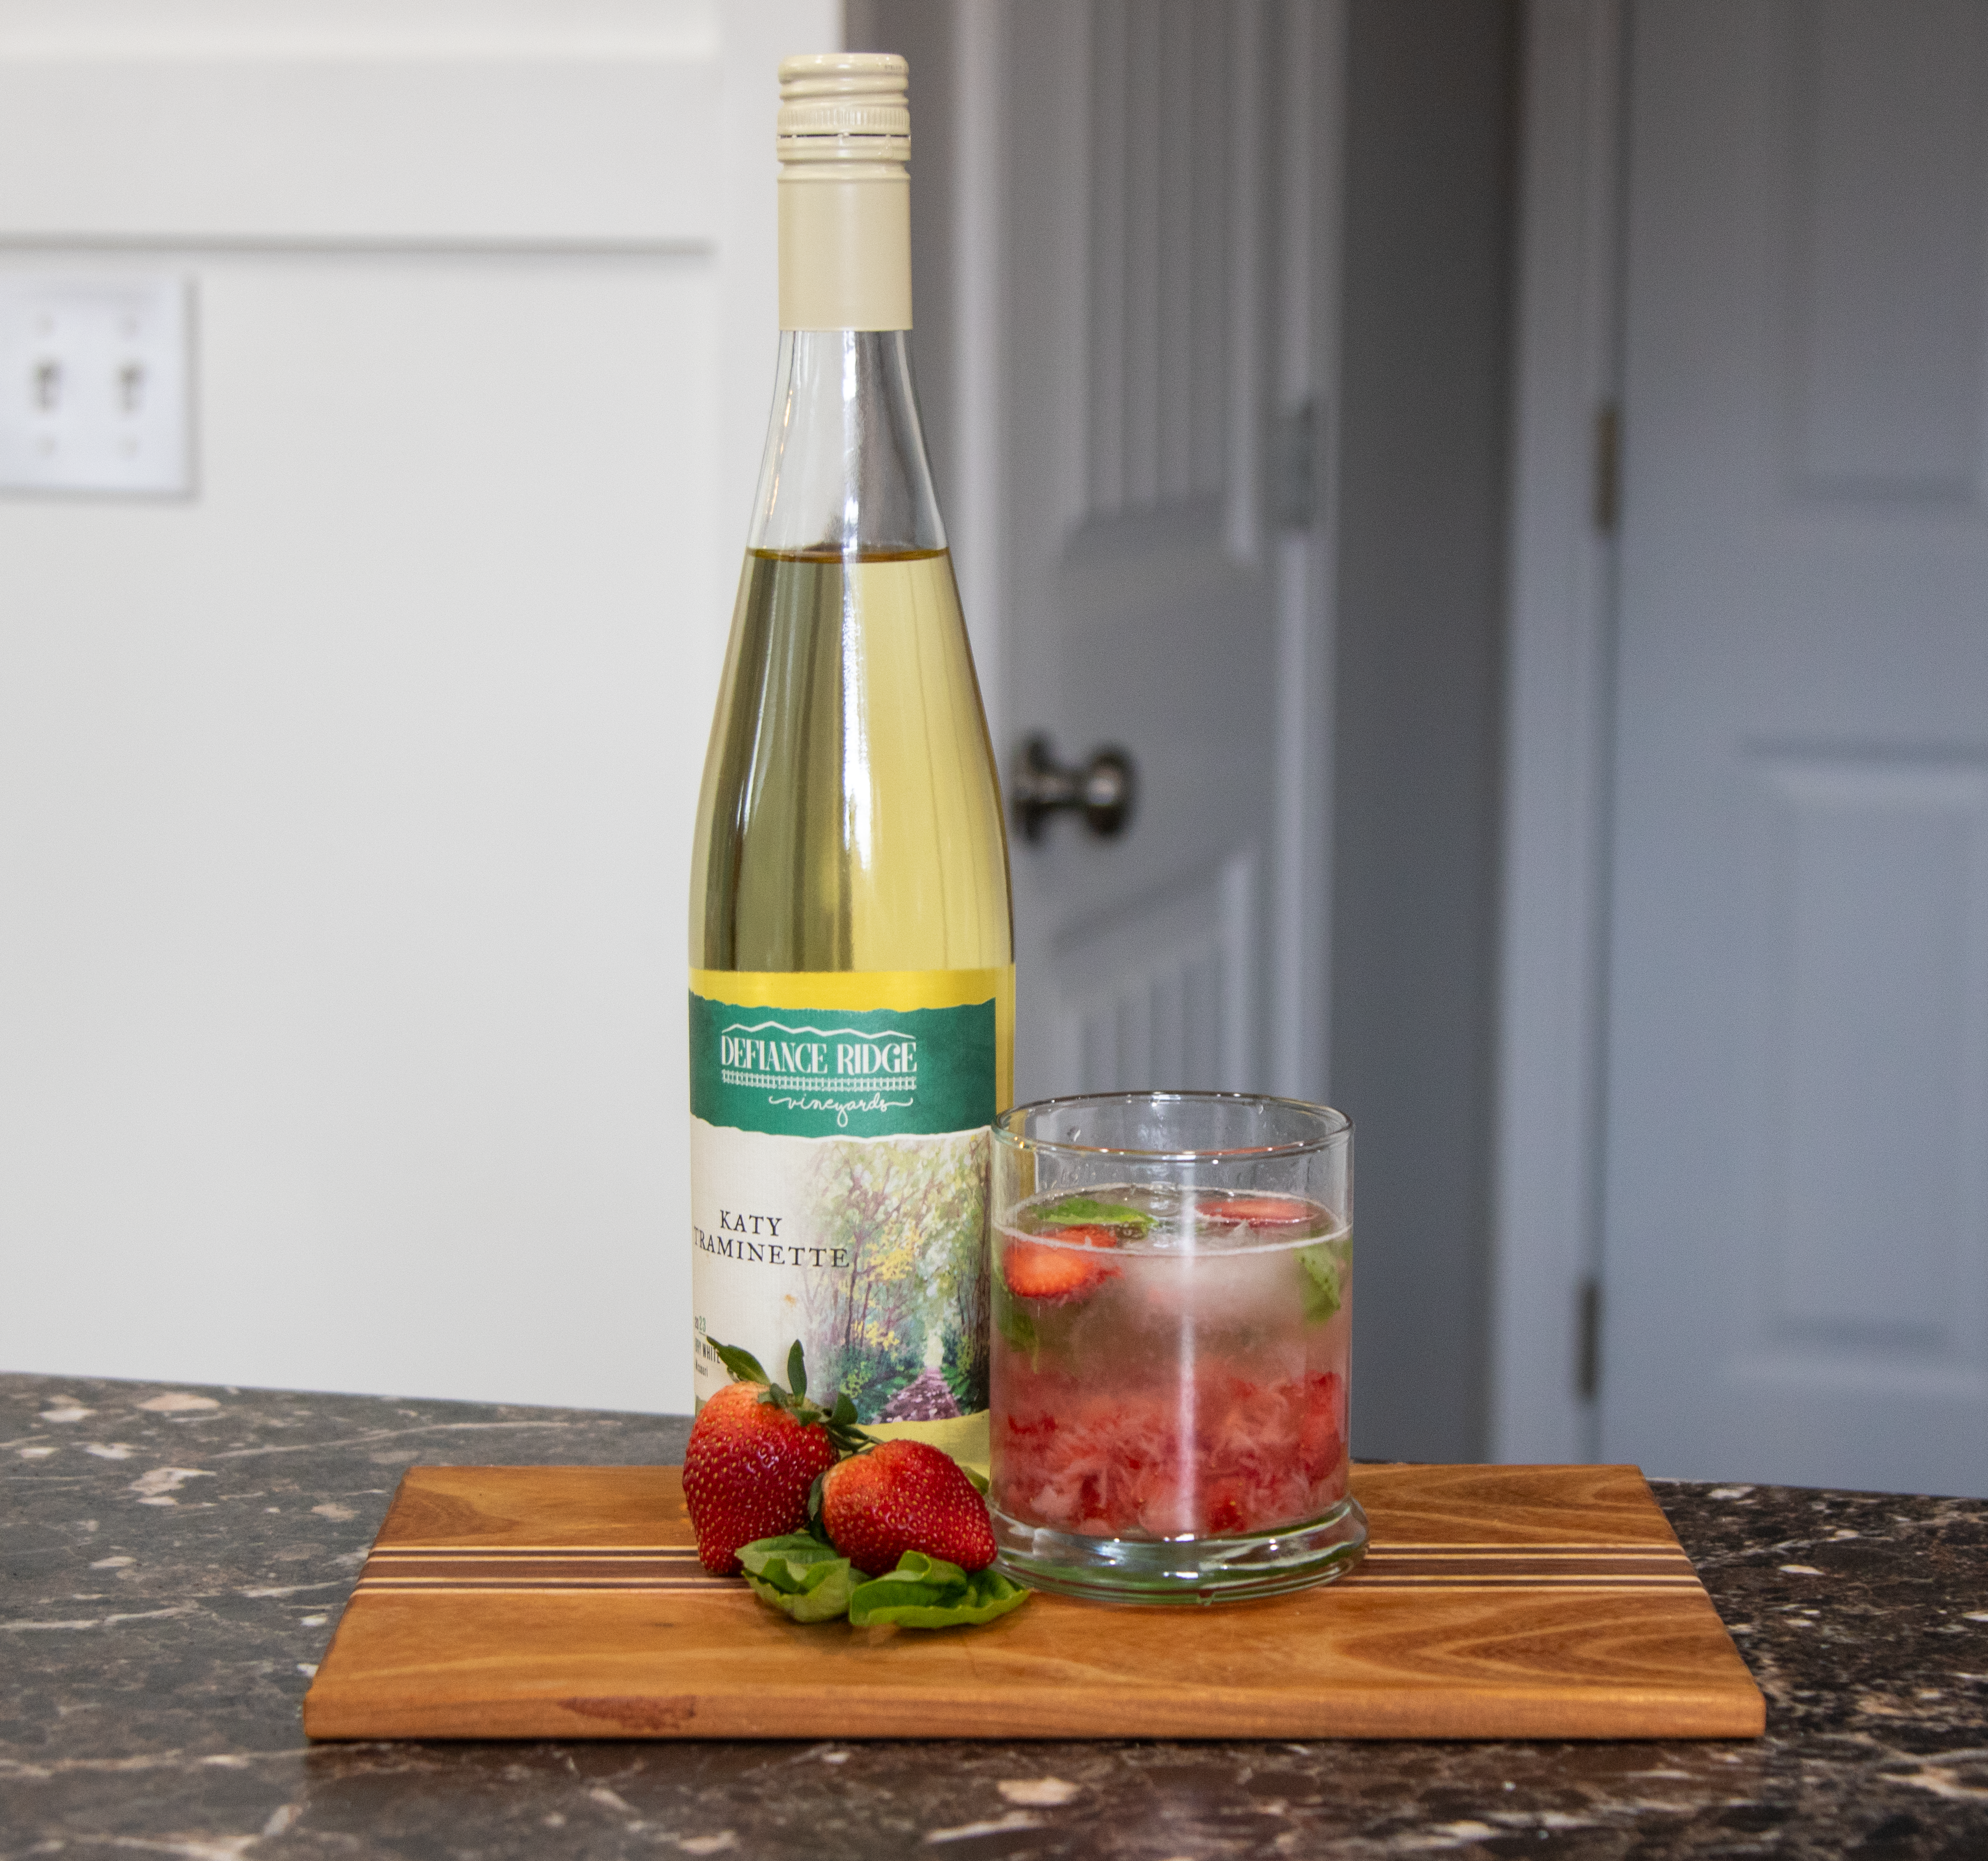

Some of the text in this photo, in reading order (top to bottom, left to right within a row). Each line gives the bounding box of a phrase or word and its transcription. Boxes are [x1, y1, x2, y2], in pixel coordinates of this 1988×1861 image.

[721, 1035, 917, 1076] DEFIANCE RIDGE
[769, 1092, 914, 1127] vineyards
[720, 1209, 782, 1236] KATY
[694, 1225, 849, 1268] TRAMINETTE
